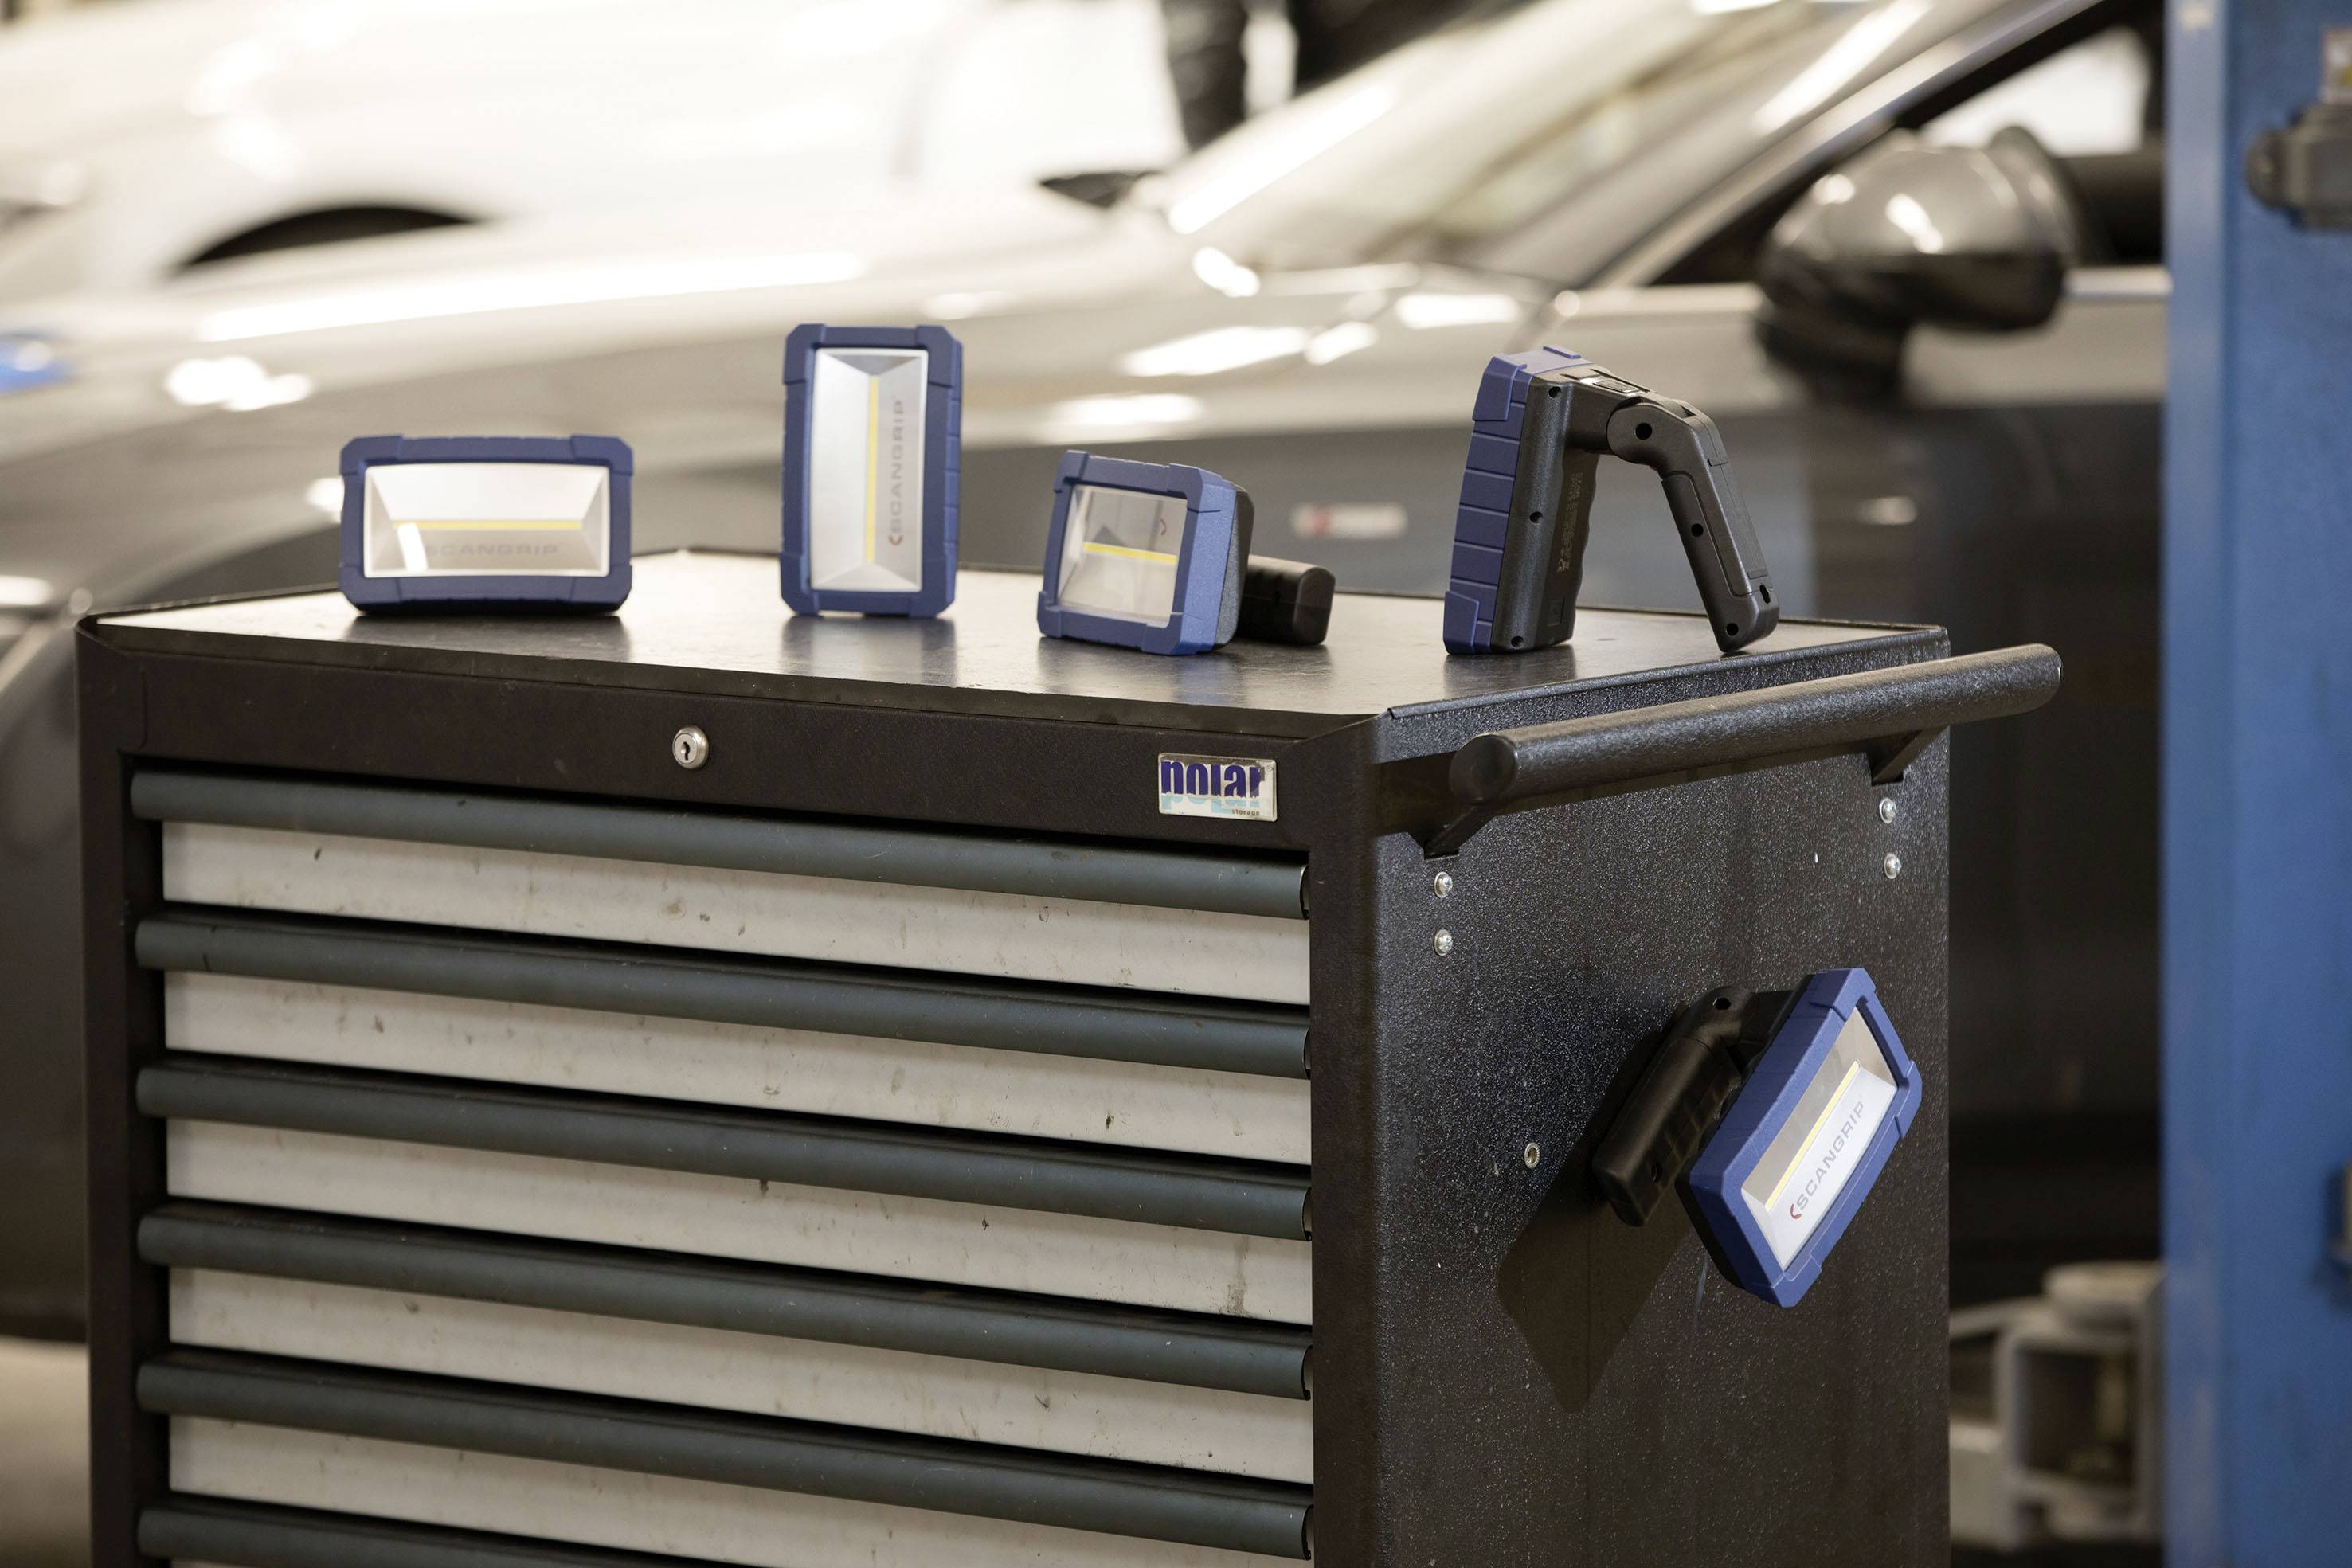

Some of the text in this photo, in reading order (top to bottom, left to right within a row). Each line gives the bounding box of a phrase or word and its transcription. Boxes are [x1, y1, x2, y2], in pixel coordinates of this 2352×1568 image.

[890, 400, 905, 534] SCANGRIP
[425, 543, 559, 557] SCANGRIP
[1796, 1101, 1865, 1211] SCANGRIP
